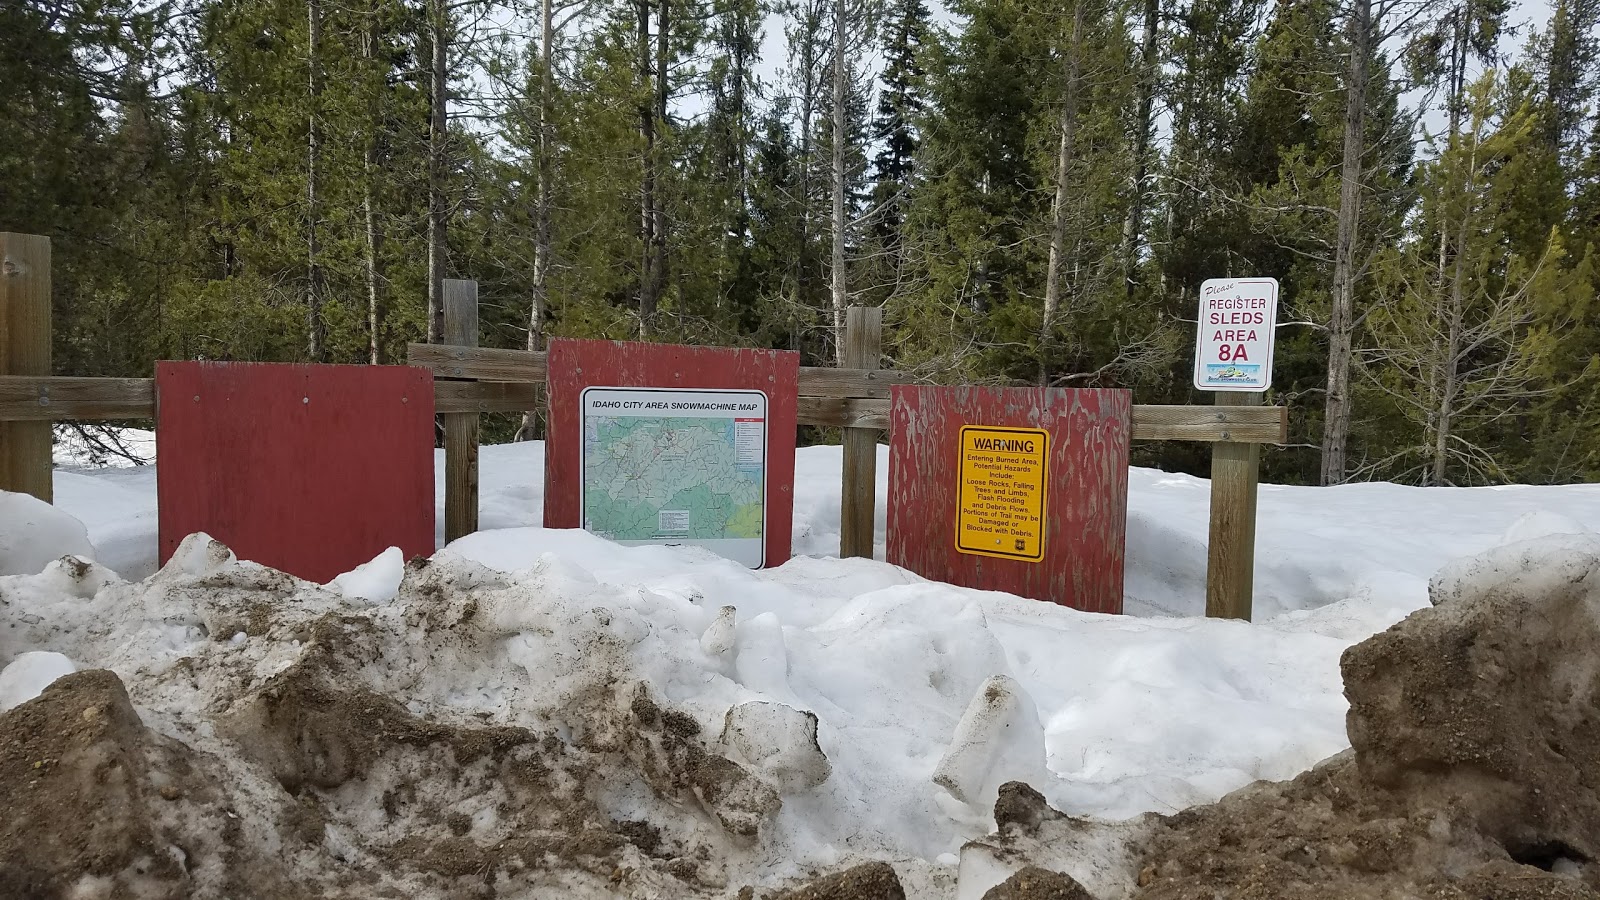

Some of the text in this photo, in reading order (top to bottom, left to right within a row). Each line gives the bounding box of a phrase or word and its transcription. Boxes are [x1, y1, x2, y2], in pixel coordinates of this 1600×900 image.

[1205, 283, 1234, 297] Please
[1209, 299, 1266, 309] REGISTER
[1210, 312, 1263, 324] SLEDS
[1213, 330, 1257, 341] AREA
[1218, 344, 1248, 361] 8A
[623, 401, 643, 409] CITY
[671, 402, 736, 410] SNOWMACHINE
[974, 438, 1034, 452] WARNING
[967, 454, 1038, 466] Entering Burned Area,
[973, 462, 1030, 472] Potential Hazards
[989, 471, 1014, 479] Include:
[989, 480, 1010, 488] Rocks,
[1013, 482, 1034, 490] Falling
[1008, 489, 1029, 497] Limbs,
[997, 495, 1024, 505] Flooding
[963, 508, 988, 516] Portions
[1009, 505, 1030, 513] Flows.
[978, 518, 1009, 526] Damaged
[966, 524, 992, 532] Blocked
[1010, 529, 1033, 537] Debris.
